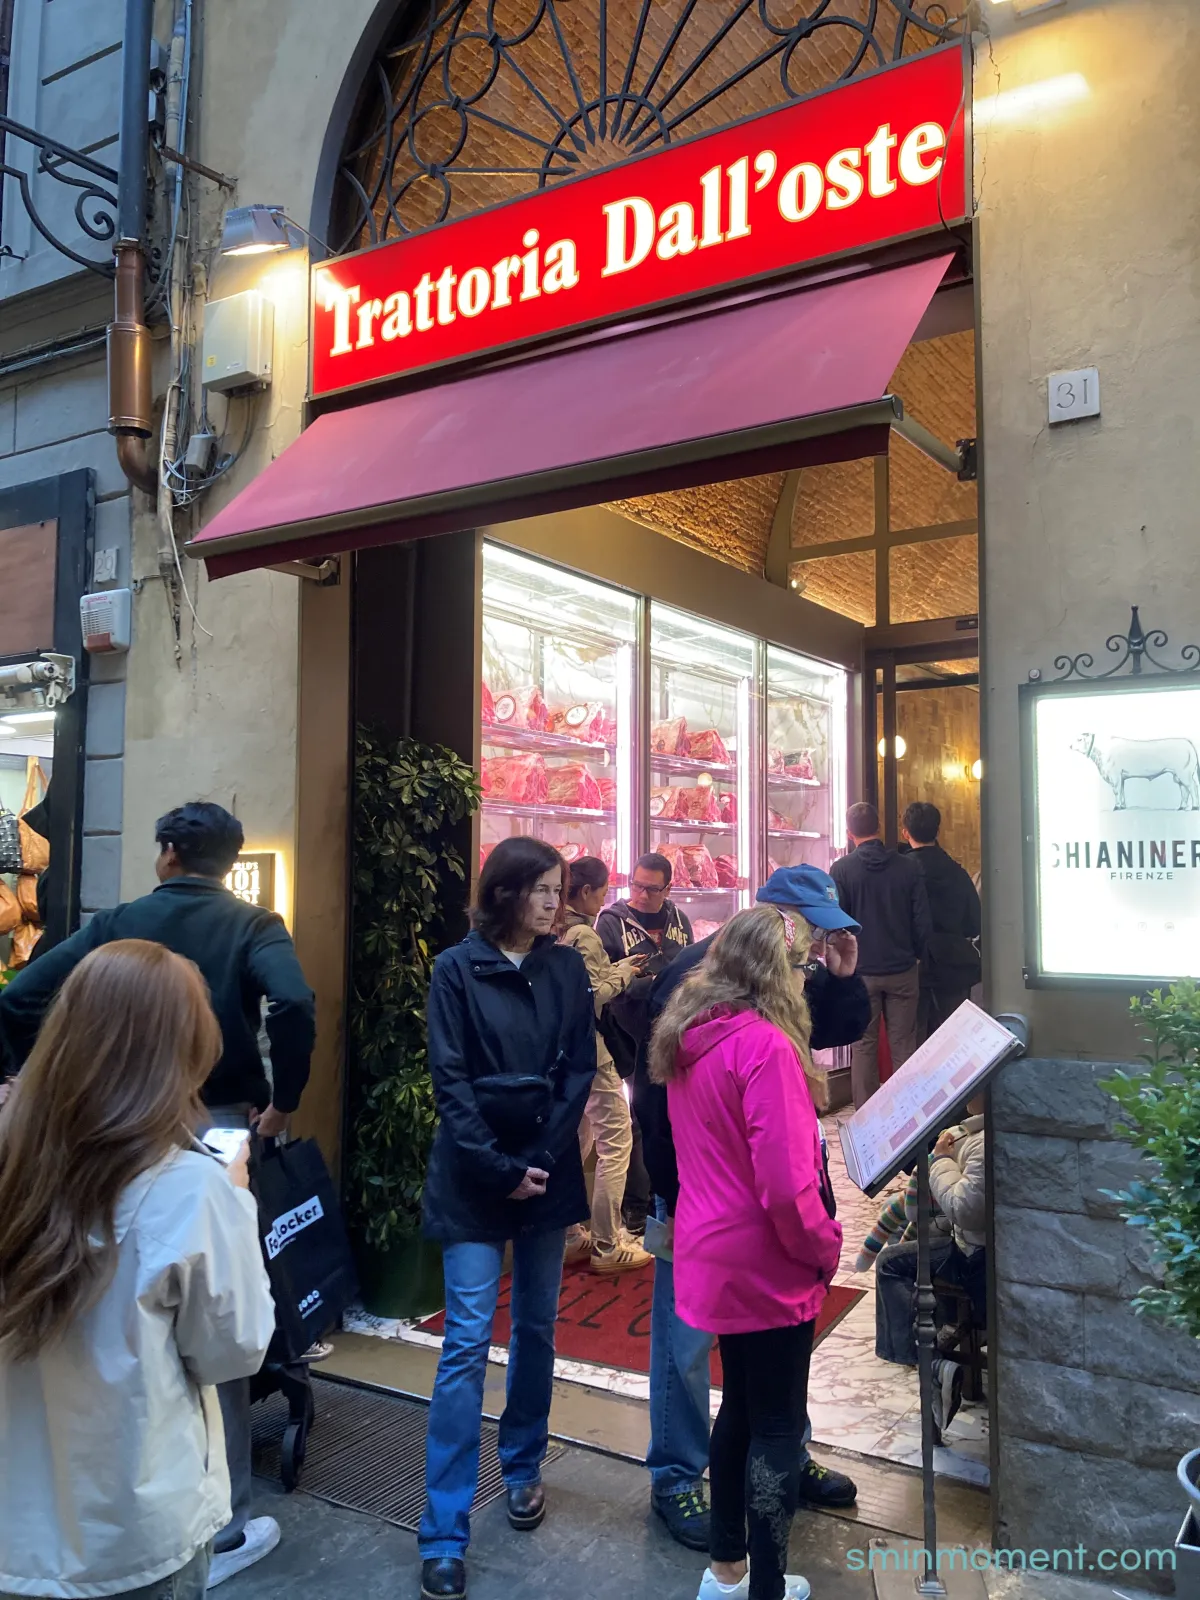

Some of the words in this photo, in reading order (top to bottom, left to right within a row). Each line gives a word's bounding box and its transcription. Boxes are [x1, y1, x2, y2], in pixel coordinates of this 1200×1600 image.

[325, 228, 580, 358] Trattoria
[1056, 378, 1088, 409] 31
[1110, 871, 1174, 881] FIRENZE
